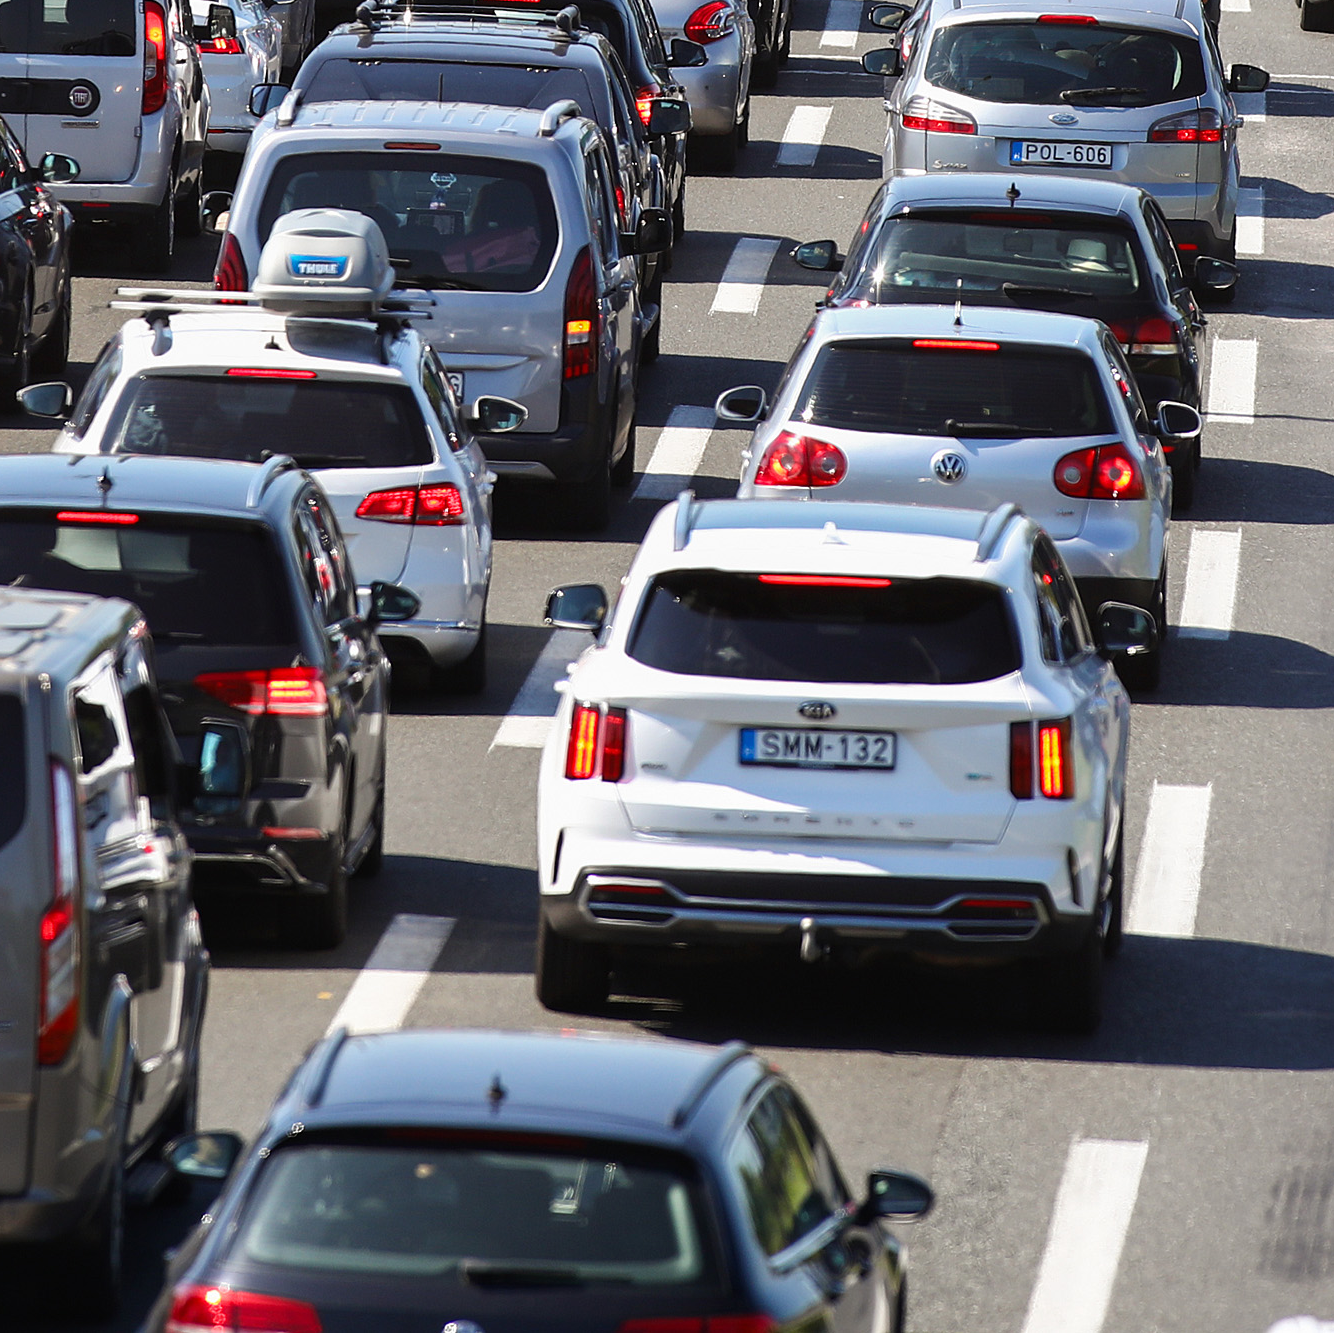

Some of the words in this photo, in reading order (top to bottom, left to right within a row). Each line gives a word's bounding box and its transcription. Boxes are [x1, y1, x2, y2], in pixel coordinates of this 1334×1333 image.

[1025, 143, 1107, 163] POL-606
[298, 263, 340, 274] THULE
[761, 730, 889, 763] SMM-132
